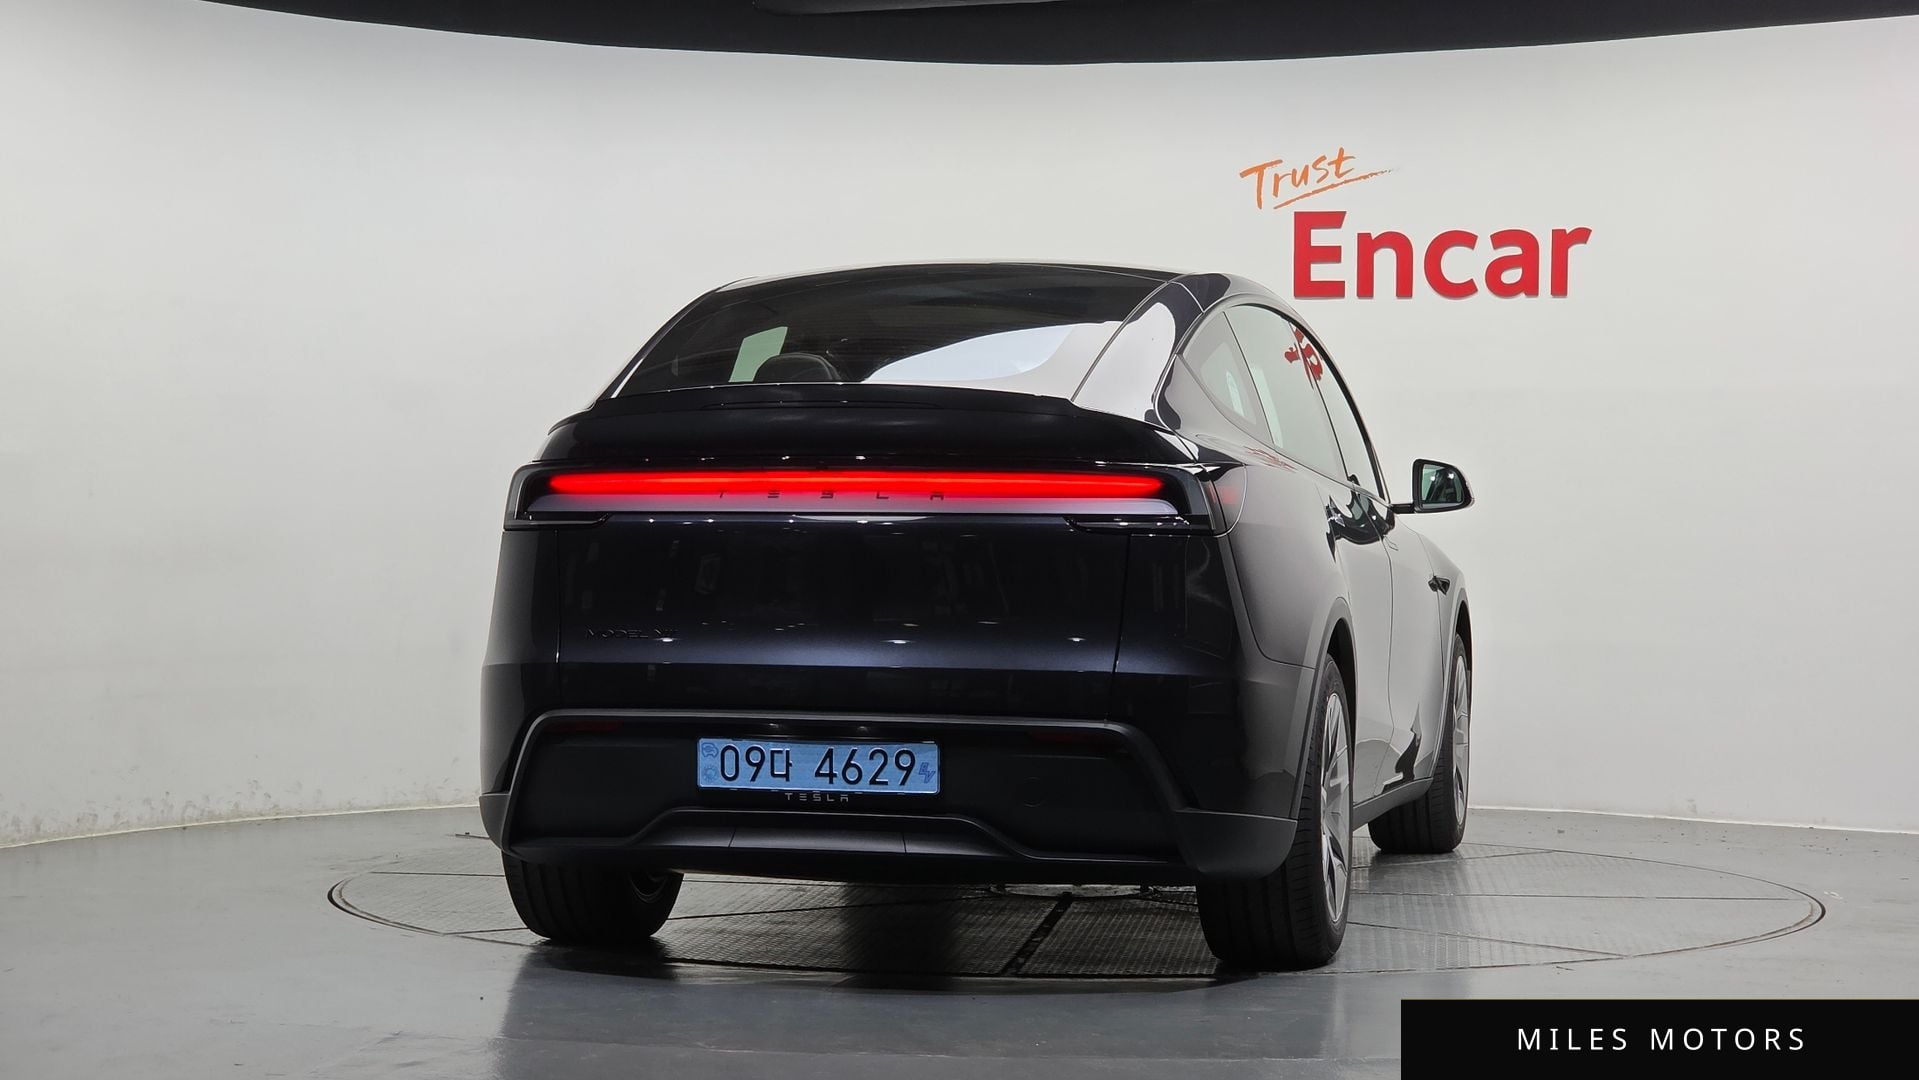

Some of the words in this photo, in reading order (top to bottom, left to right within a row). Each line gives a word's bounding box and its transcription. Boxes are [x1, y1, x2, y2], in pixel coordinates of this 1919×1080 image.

[1240, 147, 1356, 209] Trust
[1294, 211, 1592, 299] Encar
[720, 744, 793, 782] 09다
[814, 747, 916, 786] 4629
[785, 792, 849, 802] TESLA
